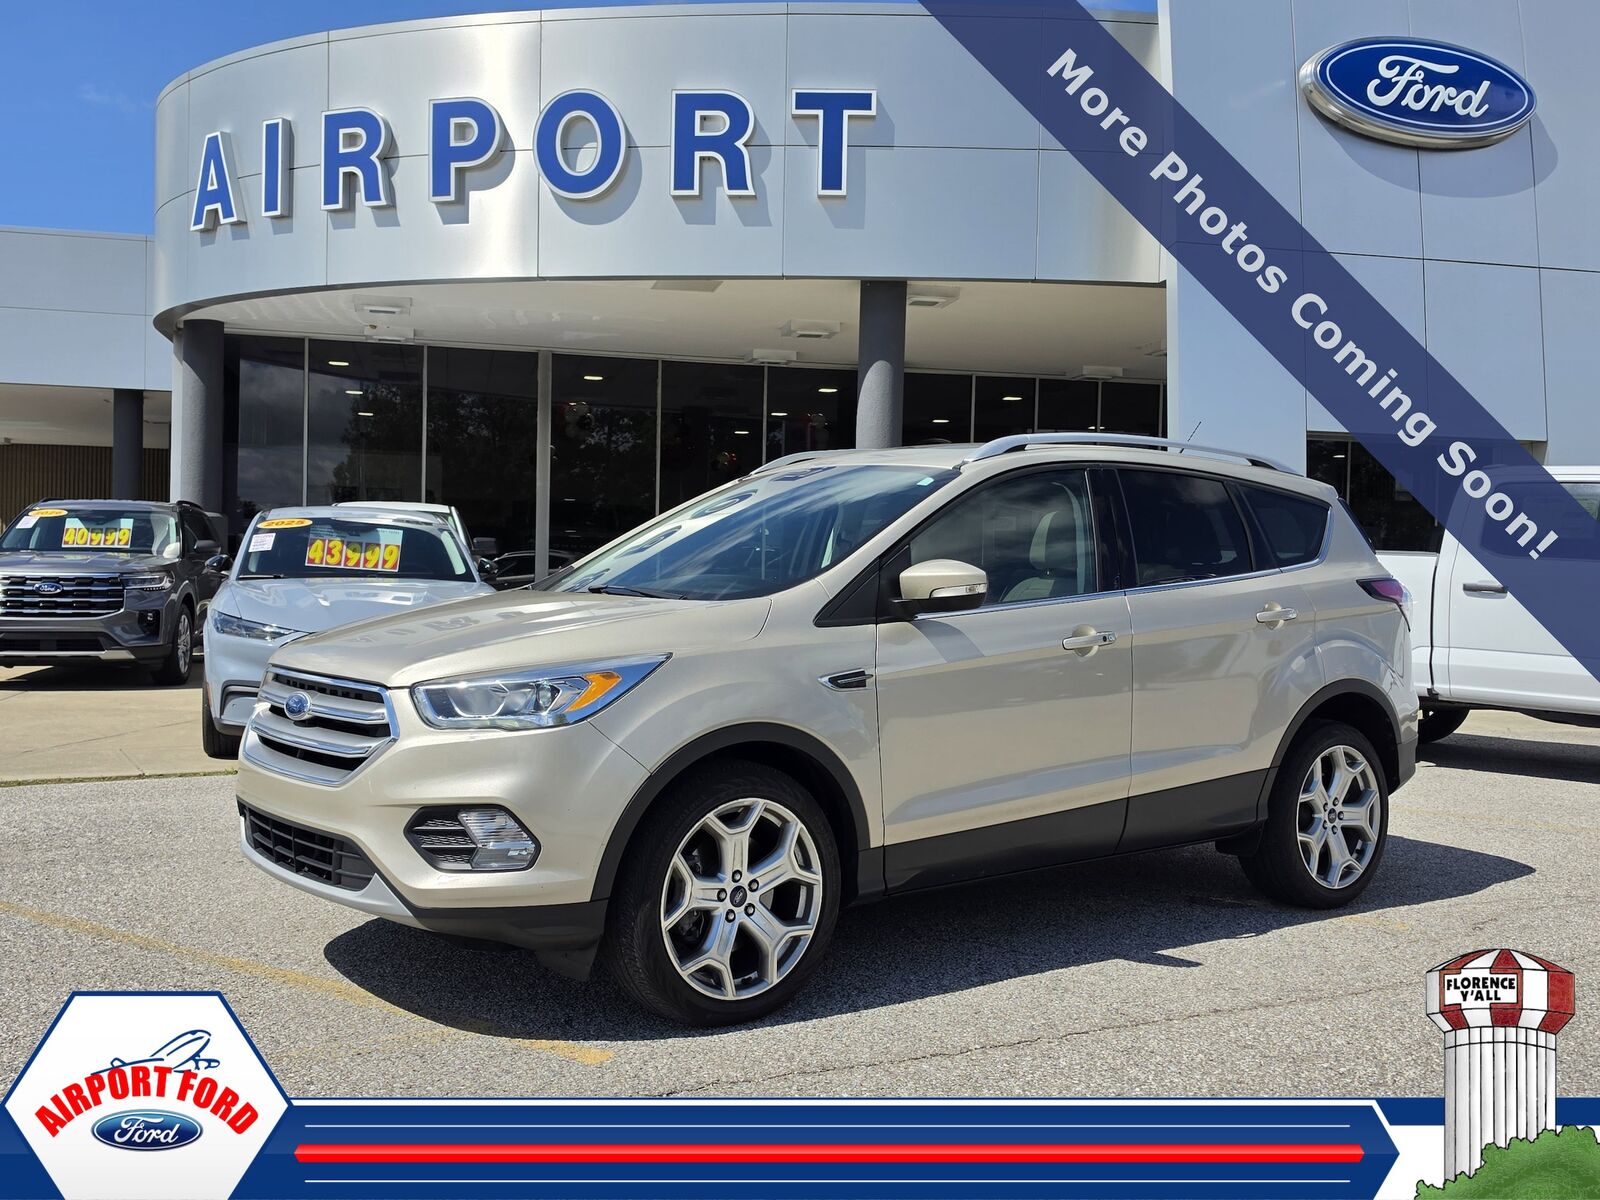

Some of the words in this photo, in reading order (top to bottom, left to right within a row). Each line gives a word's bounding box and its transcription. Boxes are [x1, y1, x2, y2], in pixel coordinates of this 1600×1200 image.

[1366, 54, 1491, 119] Ford
[190, 88, 878, 232] AIRPORT
[63, 527, 131, 546] 40999
[266, 519, 305, 527] 2025
[308, 538, 399, 570] 43999
